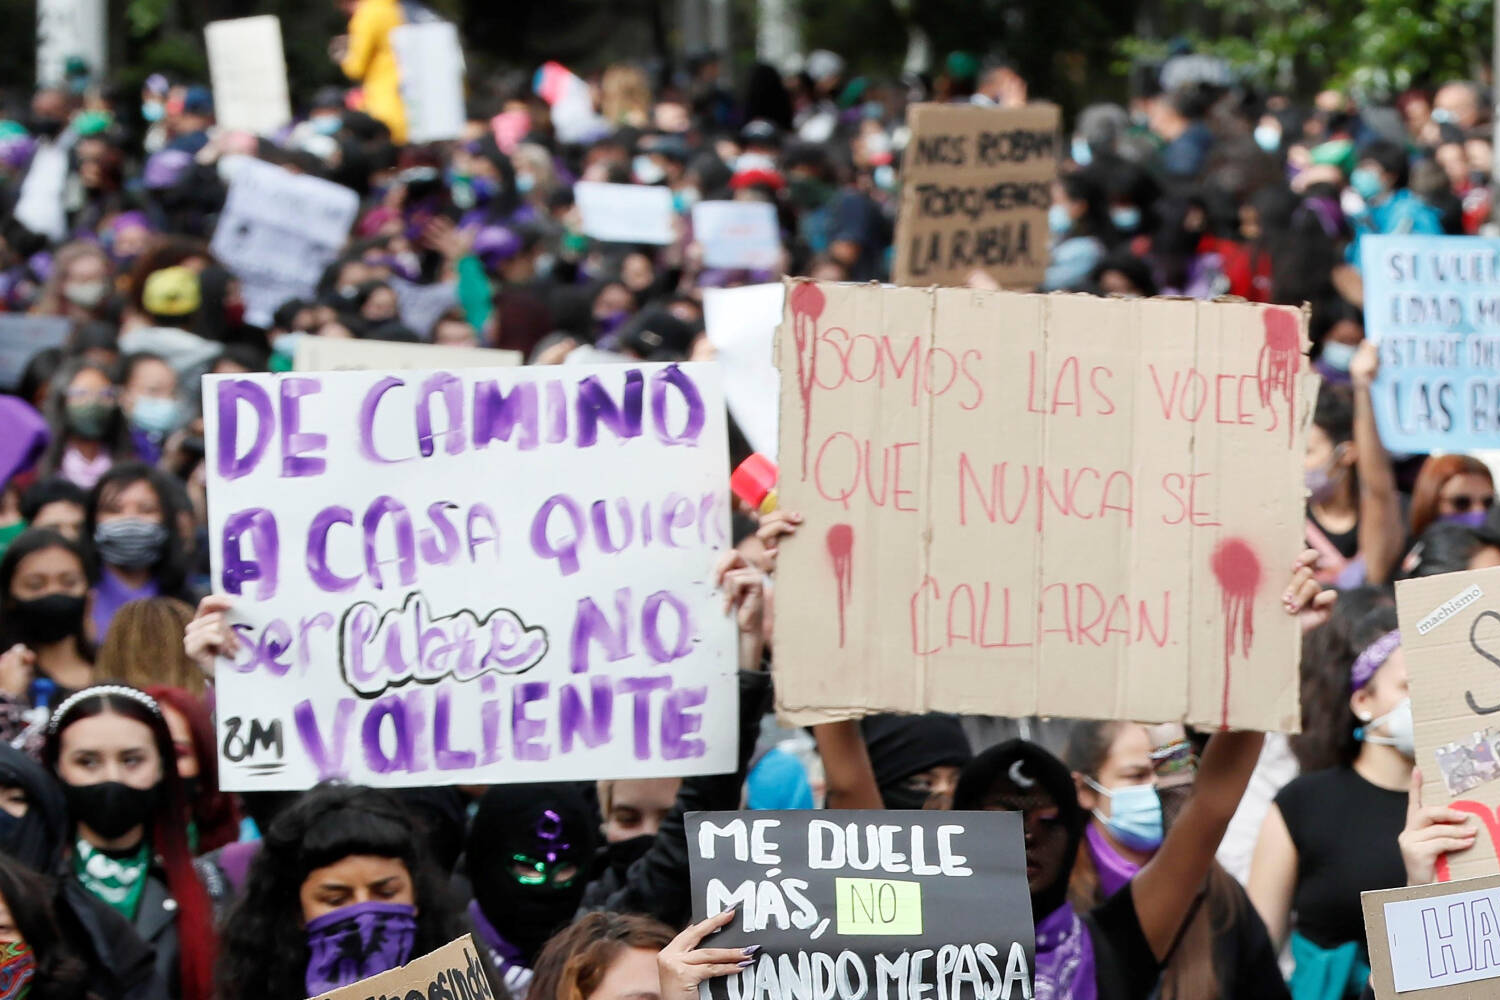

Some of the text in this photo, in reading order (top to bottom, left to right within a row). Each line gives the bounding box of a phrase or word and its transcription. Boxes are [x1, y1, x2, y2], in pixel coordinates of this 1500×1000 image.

[908, 232, 942, 276] LA
[1389, 253, 1419, 282] SI
[1390, 296, 1462, 325] EDAD
[813, 326, 1278, 432] SOMOS LAS VOCES
[1389, 378, 1453, 434] LAS
[217, 363, 706, 480] DE CAMINO
[814, 431, 1223, 533] QUE NUNCA SE
[221, 506, 280, 600] A
[306, 494, 499, 593] CASA
[568, 586, 698, 674] NO
[1419, 588, 1481, 632] machismo
[222, 717, 284, 762] 8M
[698, 818, 973, 877] ME DUELE
[850, 882, 897, 925] NO
